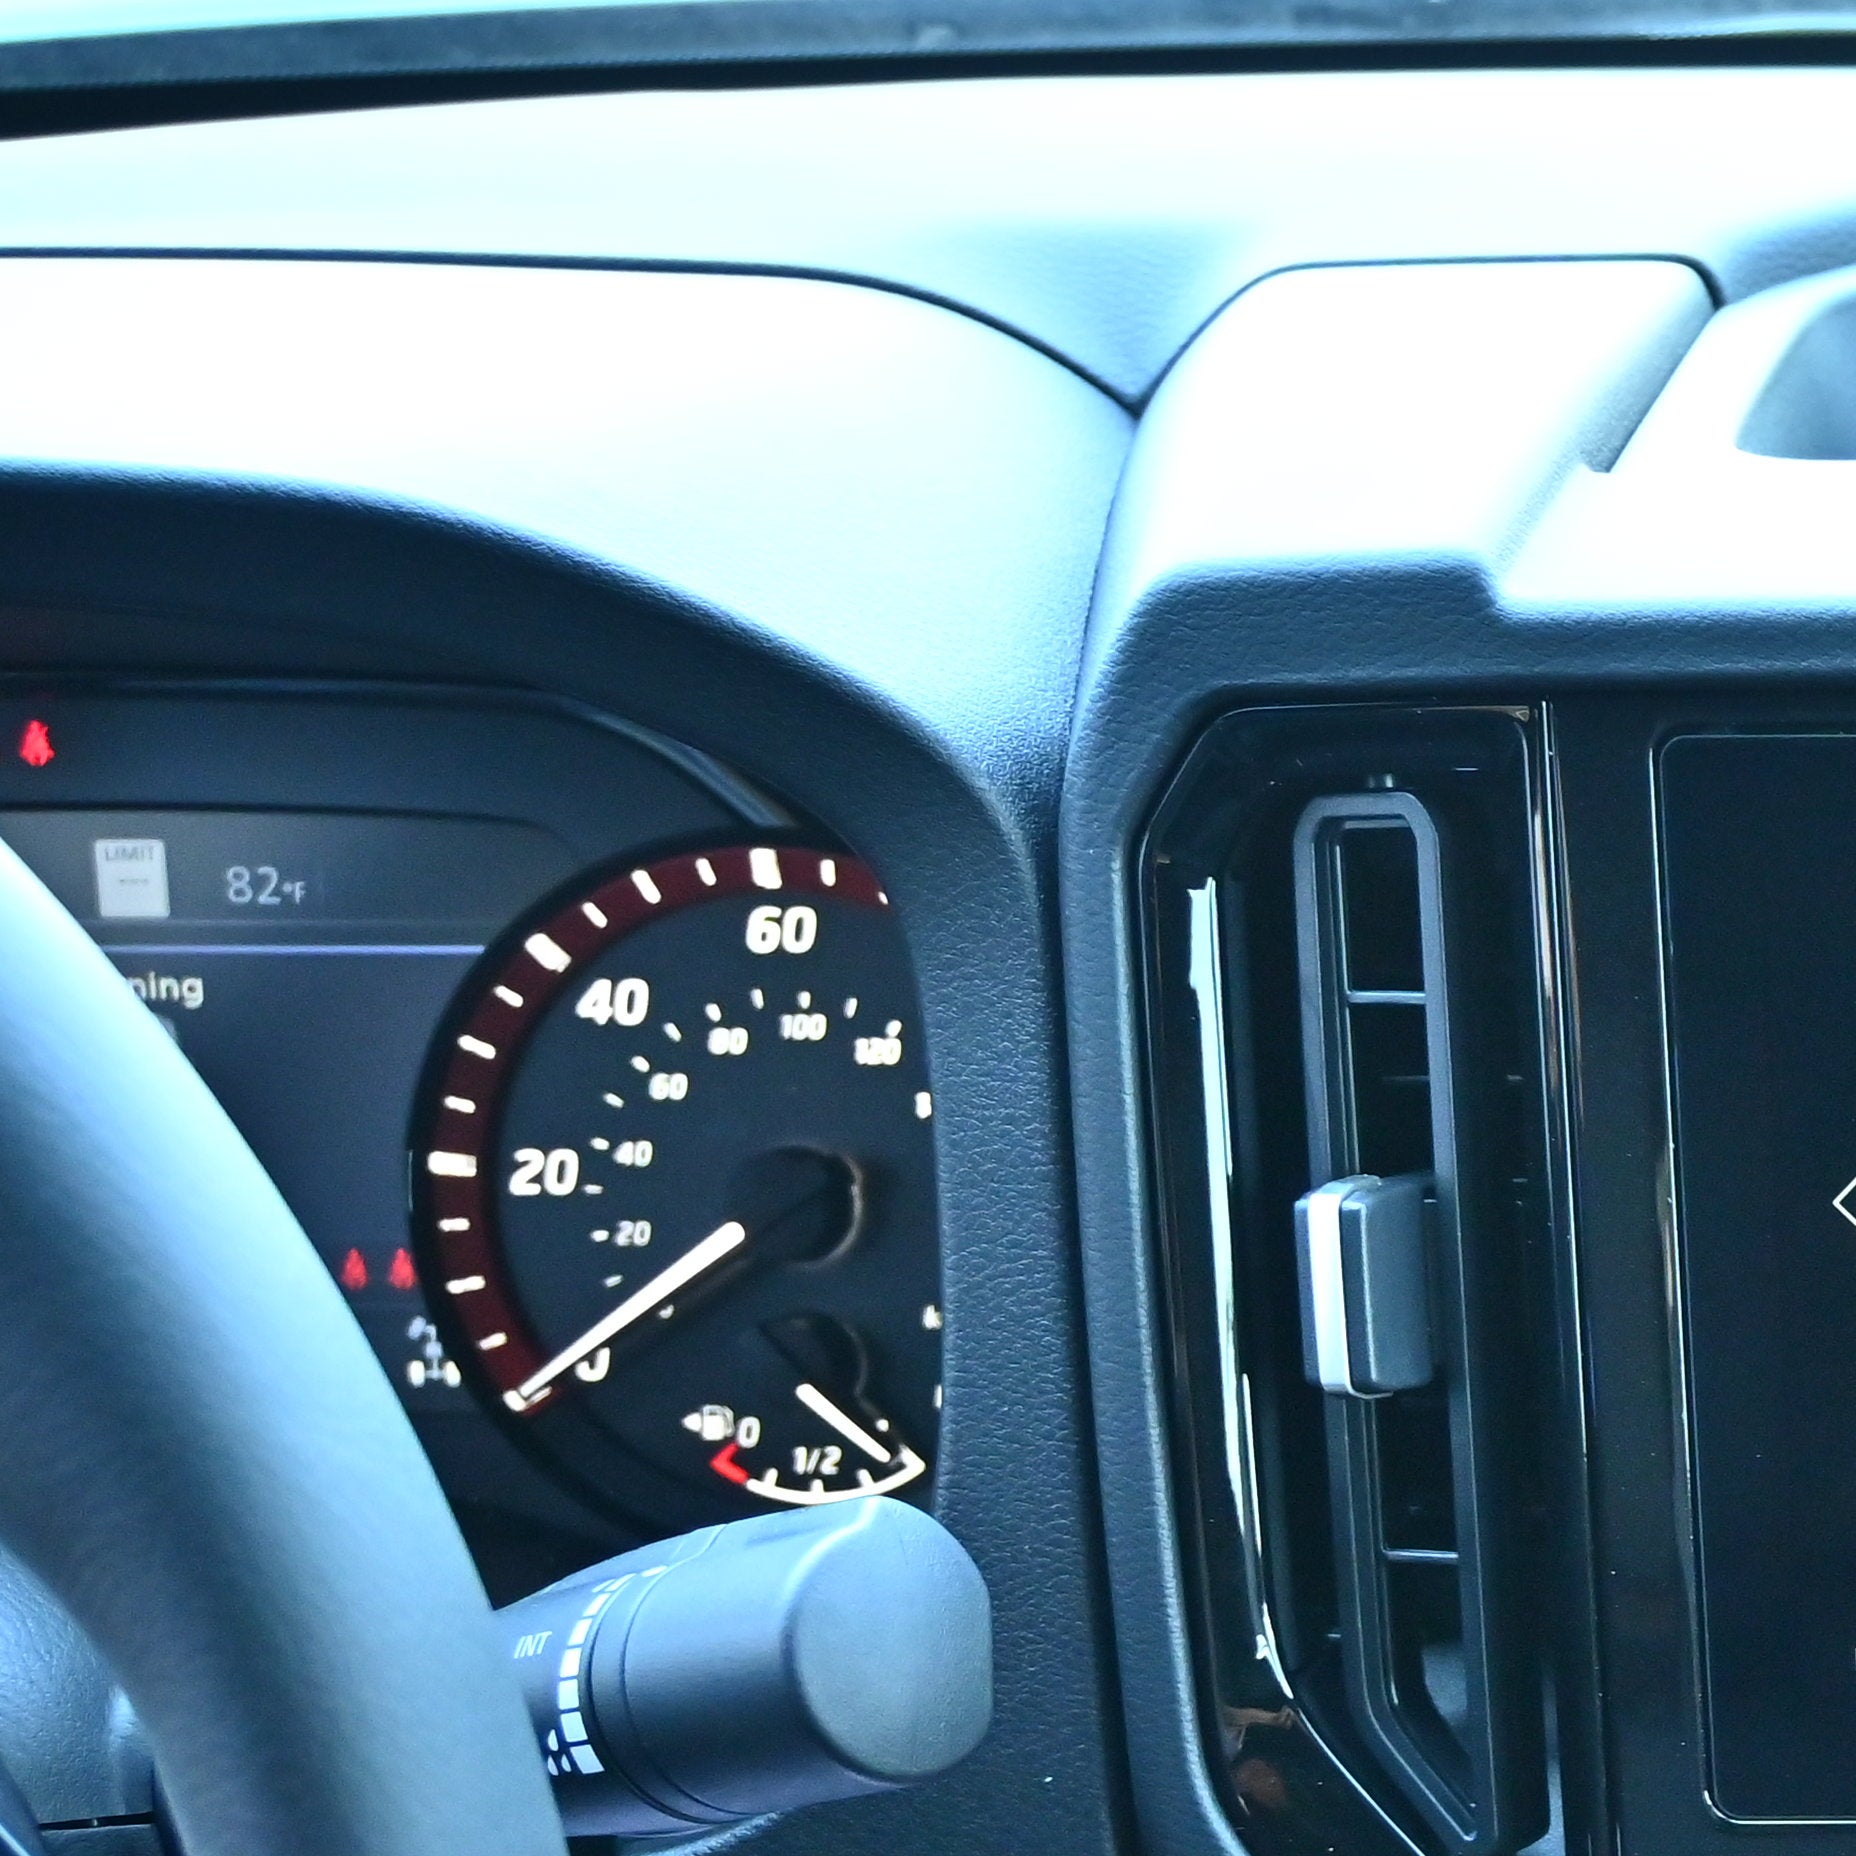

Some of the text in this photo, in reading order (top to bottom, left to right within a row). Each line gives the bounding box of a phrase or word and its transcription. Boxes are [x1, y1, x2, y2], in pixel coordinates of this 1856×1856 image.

[745, 905, 818, 955] 60
[126, 970, 204, 1009] ning
[574, 977, 650, 1027] 40
[779, 1013, 827, 1041] 100
[612, 1140, 653, 1168] 40
[508, 1147, 579, 1196] 20
[614, 1220, 652, 1247] 20
[793, 1445, 842, 1476] 1/2
[512, 1630, 553, 1660] INT
